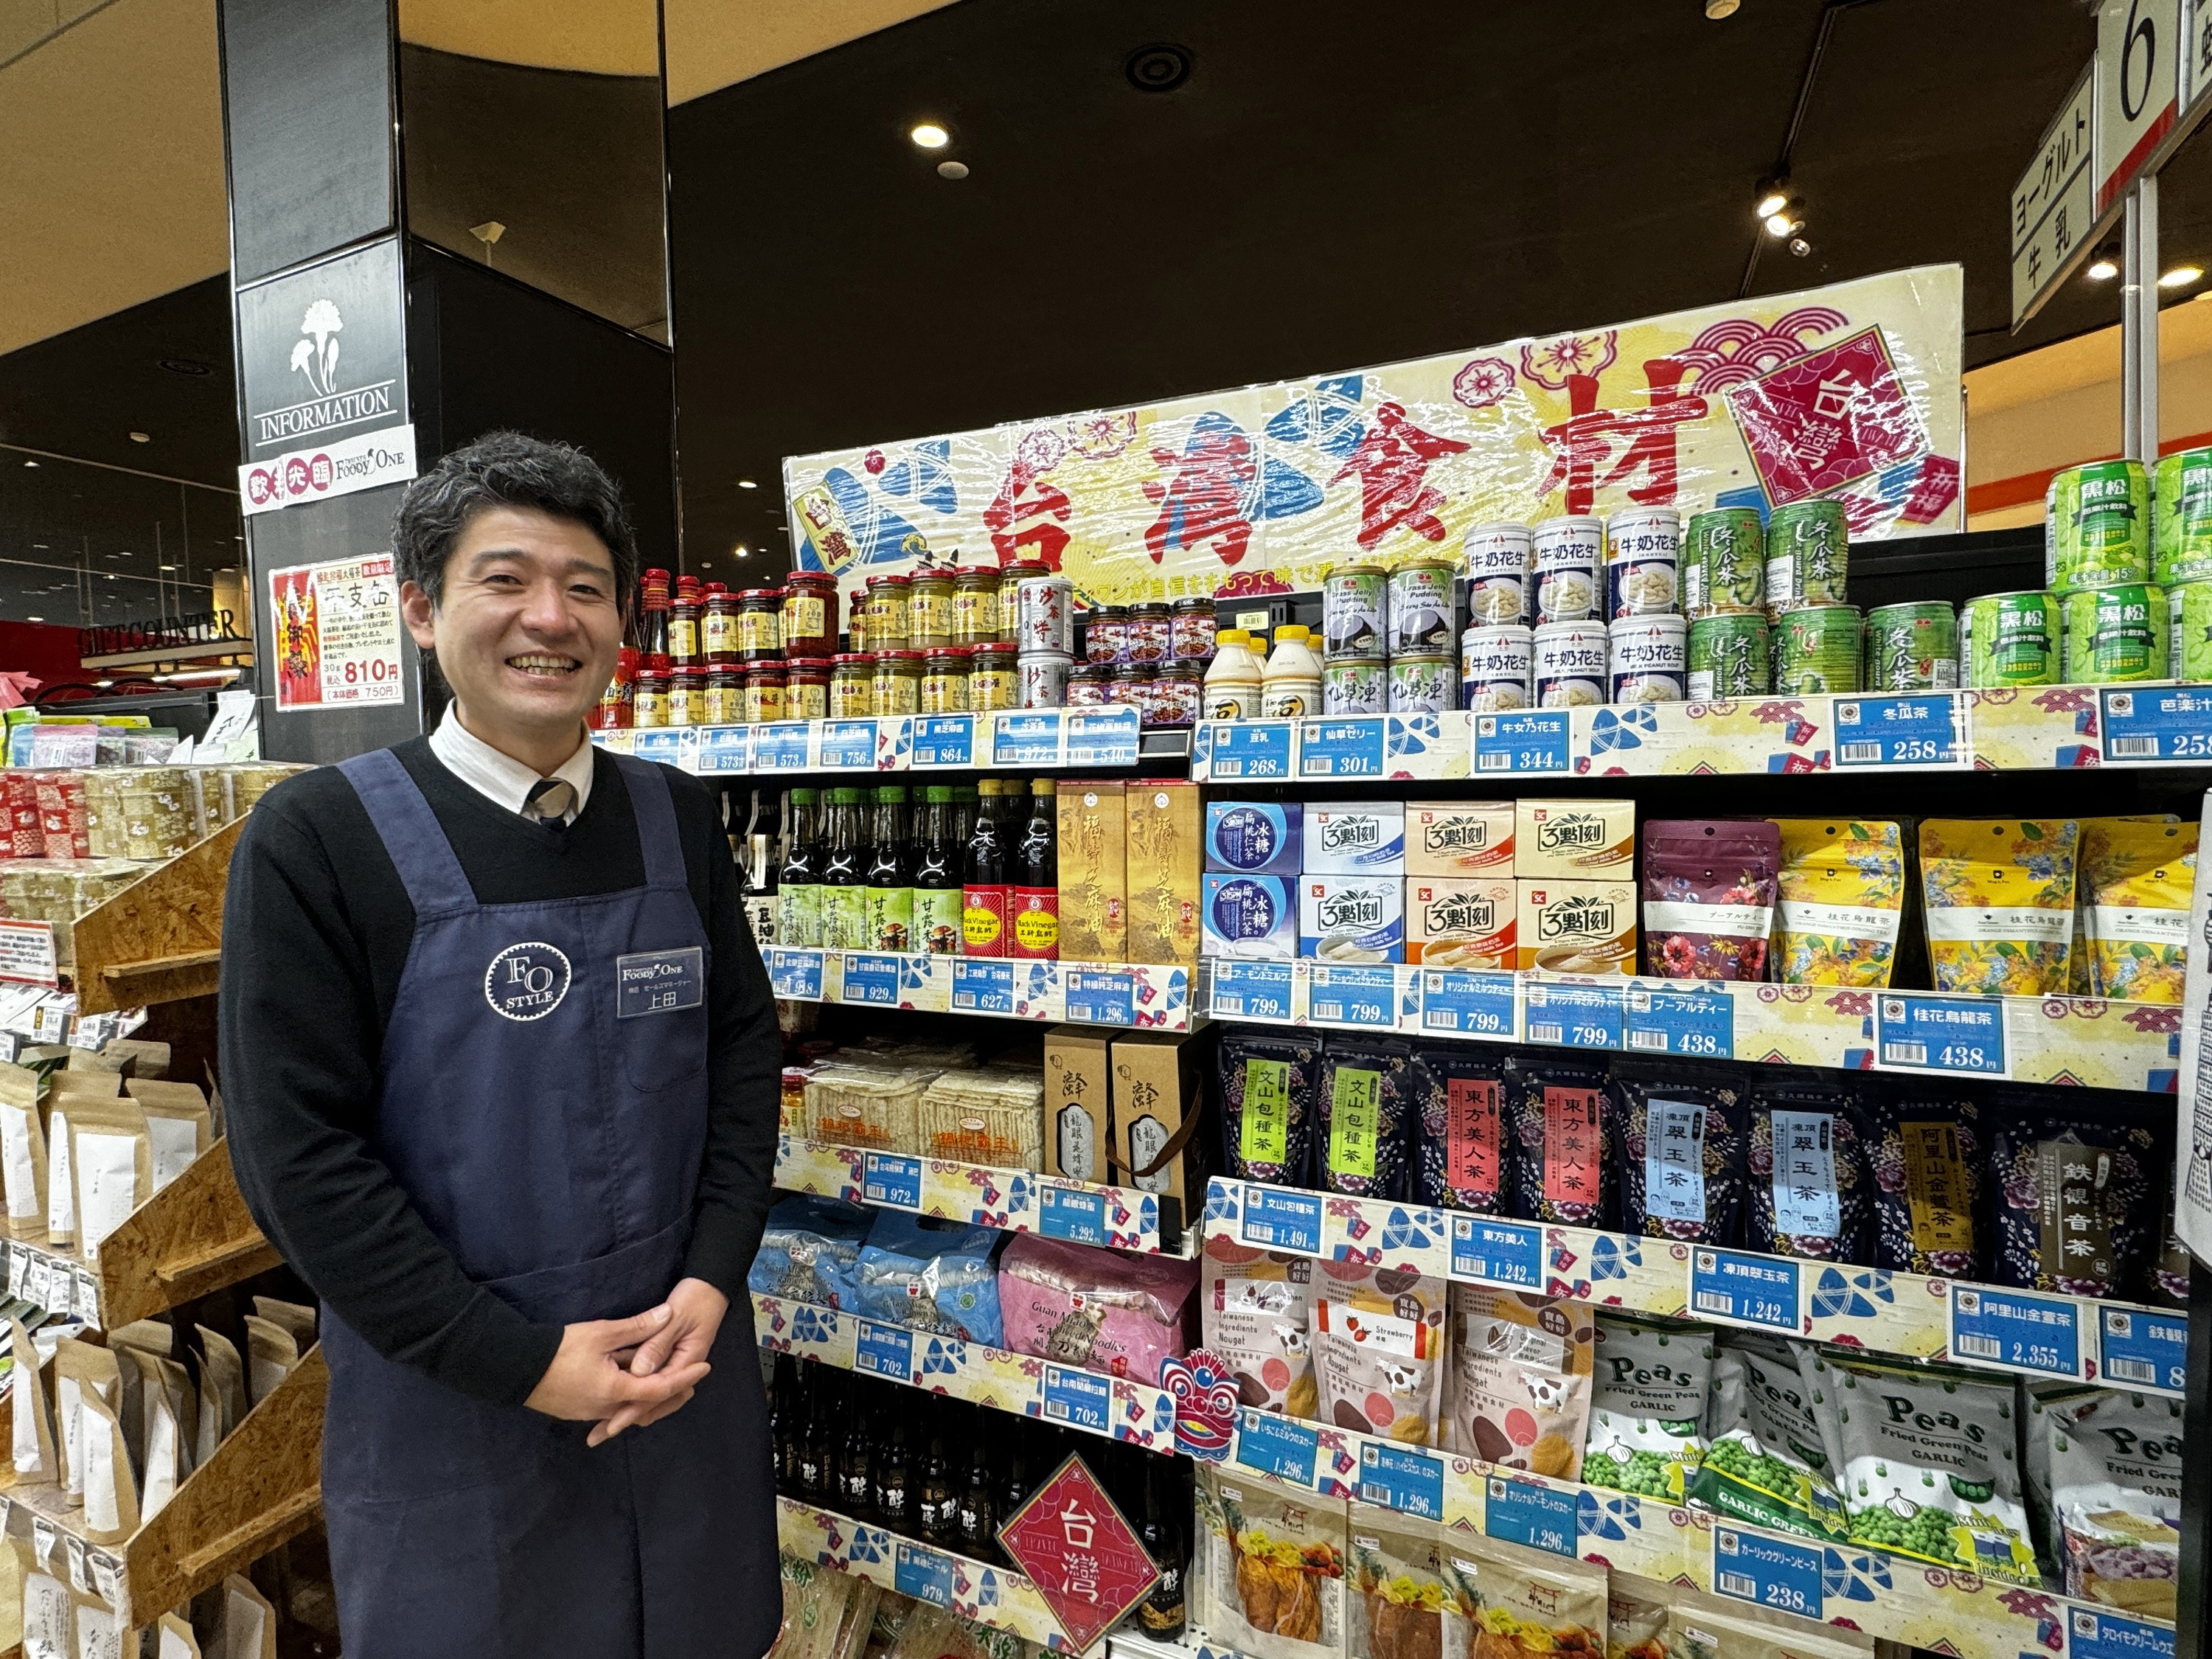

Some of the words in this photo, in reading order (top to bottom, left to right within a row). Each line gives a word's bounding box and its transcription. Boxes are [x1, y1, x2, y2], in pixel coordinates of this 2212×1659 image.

[2121, 0, 2154, 121] 6
[2017, 108, 2085, 237] ヨーグルト
[2028, 204, 2070, 289] 牛乳
[260, 386, 389, 440] INFORMATION
[2081, 479, 2129, 499] 黑松
[1540, 543, 1596, 560] 牛奶花生
[1621, 535, 1678, 552] 牛奶花生
[1809, 520, 1837, 580] 冬瓜茶
[1471, 552, 1526, 567] 牛奶花生
[1410, 591, 1442, 599] Pudding
[2000, 610, 2045, 627] 黑松
[2098, 604, 2147, 622] 黑松
[129, 609, 240, 650] COUNTER
[1544, 650, 1604, 667] 牛奶花生
[1621, 644, 1683, 662] 牛奶花生
[345, 658, 398, 683] 810円
[1472, 654, 1529, 672] 牛奶花生
[1728, 635, 1756, 695] 冬瓜茶
[1883, 706, 1929, 720] 冬瓜茶
[1325, 729, 1376, 741] 仙草ゼリー
[1501, 721, 1562, 734] 牛女乃花生
[1251, 732, 1269, 743] 豆乳
[847, 752, 872, 766] 756円
[939, 748, 967, 762] 864円
[1893, 740, 1949, 759] 258円
[780, 754, 804, 768] 573円
[1248, 759, 1284, 775] 268円
[1340, 756, 1378, 773] 301円
[1520, 751, 1563, 769] 344円
[1255, 821, 1270, 853] 冰糖
[1325, 825, 1374, 846] 3點1刻
[1428, 827, 1482, 847] 3點1刻
[1541, 826, 1601, 846] 3點1刻
[1253, 895, 1269, 928] 冰糖
[1321, 903, 1377, 925] 3點1刻
[1428, 906, 1489, 930] 3點1刻
[1827, 912, 1891, 925] 桂花烏龍茶
[1542, 908, 1608, 935] 3點1刻
[506, 990, 554, 1009] STYLE
[647, 991, 676, 1010] 上田
[869, 986, 894, 1001] 929円
[981, 994, 1009, 1010] 627円
[1251, 998, 1285, 1016] 799円
[1350, 1004, 1388, 1023] 799円
[1654, 999, 1728, 1015] プーアルティー
[1914, 1008, 1993, 1025] 桂花烏龍茶
[1467, 1013, 1508, 1032] 799円
[1572, 1026, 1617, 1048] 799円
[1677, 1034, 1727, 1055] 438円
[1939, 1046, 1996, 1069] 438円
[1253, 1070, 1275, 1152] 文山包種茶
[1666, 1112, 1690, 1123] 凍頂
[1342, 1079, 1366, 1164] 文山包種茶
[1791, 1122, 1817, 1133] 凍頂
[1464, 1090, 1486, 1179] 東方美人茶
[1562, 1099, 1585, 1190] 東方美人茶
[1664, 1124, 1688, 1188] 翠玉茶
[1791, 1136, 1820, 1201] 翠玉茶
[890, 1188, 917, 1206] 972円
[2062, 1163, 2096, 1257] 鉄観音茶
[1483, 1230, 1528, 1246] 東方美人
[1722, 1262, 1790, 1284] 凍頂翠玉茶
[1032, 1301, 1057, 1318] Guan
[1060, 1312, 1087, 1329] Miao
[1218, 1312, 1254, 1322] Taiwanese
[1984, 1301, 2072, 1326] 阿里山金萱茶
[1218, 1320, 1258, 1333] Ingredients
[1376, 1326, 1413, 1341] Strawberry
[2149, 1325, 2187, 1342] 鉄観
[1056, 1323, 1084, 1341] Sliced
[1085, 1334, 1127, 1352] Noodles
[1218, 1329, 1245, 1346] Nougat
[1327, 1335, 1357, 1354] Taiwanese
[1461, 1345, 1499, 1366] Taiwanese
[883, 1359, 908, 1377] 702円
[1607, 1357, 1692, 1386] Peas
[1638, 1389, 1672, 1399] Green
[1675, 1390, 1700, 1399] Peas
[1630, 1401, 1676, 1412] GARLIC
[1075, 1406, 1105, 1427] 702円
[1880, 1395, 1986, 1443] Peas
[1880, 1426, 1916, 1443] Fried
[1920, 1434, 1961, 1451] Green
[1964, 1446, 1989, 1462] Peas
[1912, 1449, 1966, 1467] GARLIC
[2107, 1461, 2144, 1478] Fried
[1719, 1491, 1768, 1521] GARLIC
[1060, 1498, 1100, 1603] 台灣
[1742, 1543, 1818, 1572] ガーリックグリーンピース
[1765, 1584, 1816, 1615] 238円
